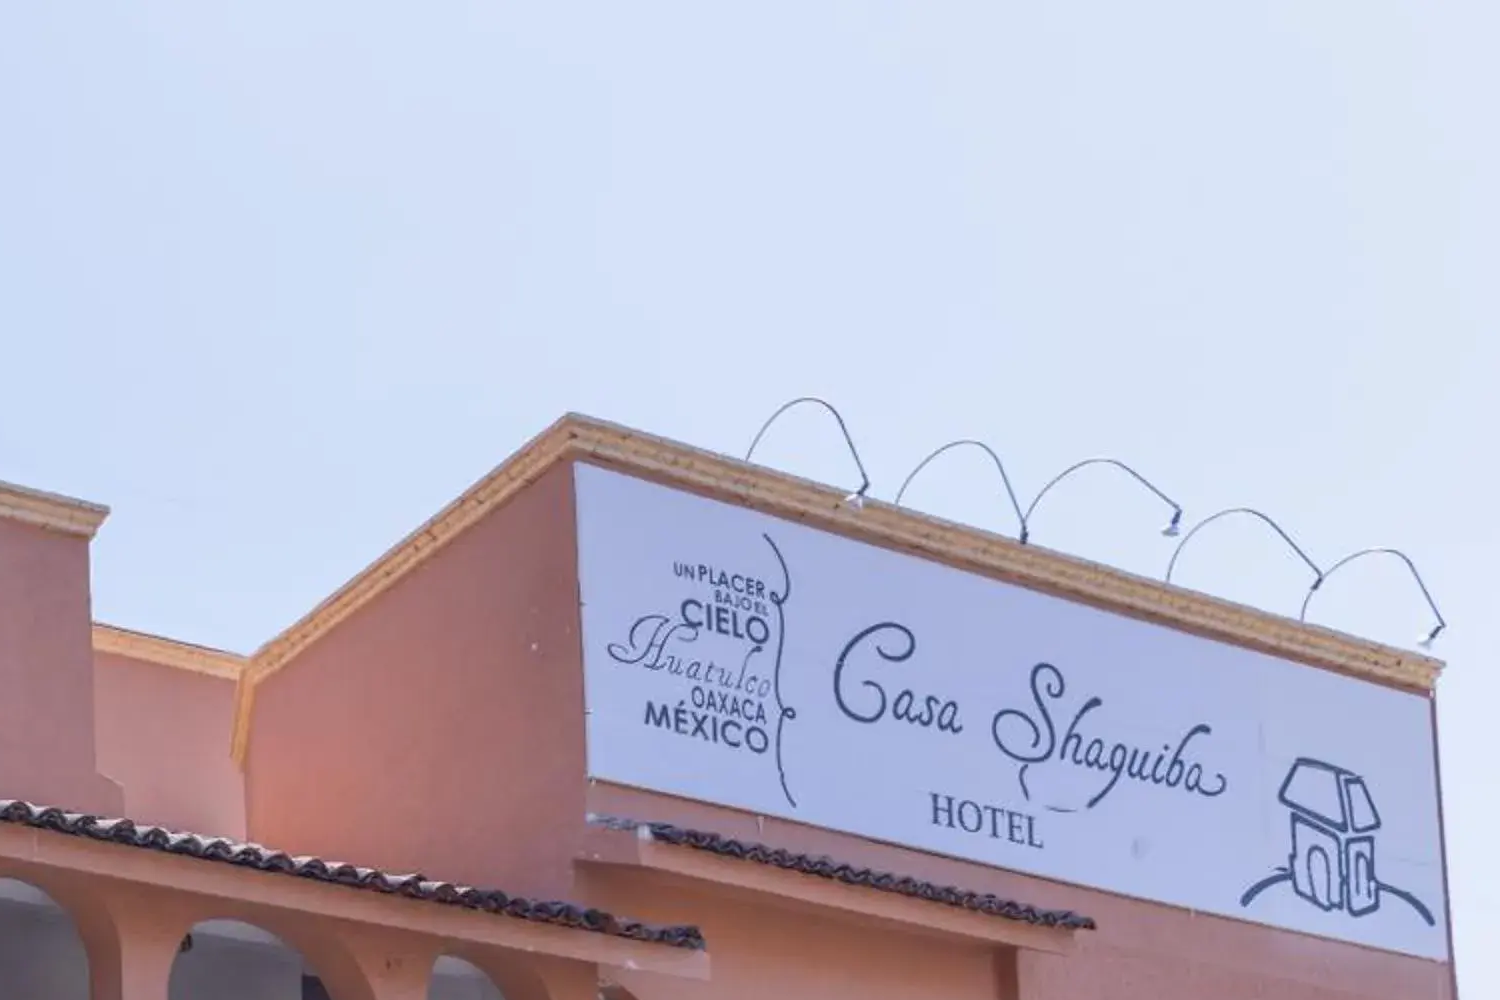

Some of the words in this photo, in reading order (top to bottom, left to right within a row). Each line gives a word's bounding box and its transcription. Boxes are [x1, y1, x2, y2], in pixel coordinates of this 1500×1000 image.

[673, 561, 695, 580] UN
[697, 564, 766, 600] PLACER
[714, 589, 752, 611] BAJO
[753, 600, 768, 617] EL
[681, 598, 769, 644] CIELO
[607, 614, 771, 699] Huatulco
[833, 621, 963, 734] Casa
[644, 700, 769, 754] MÉXICO
[691, 685, 767, 725] OAXACA
[929, 792, 1044, 849] HOTEL
